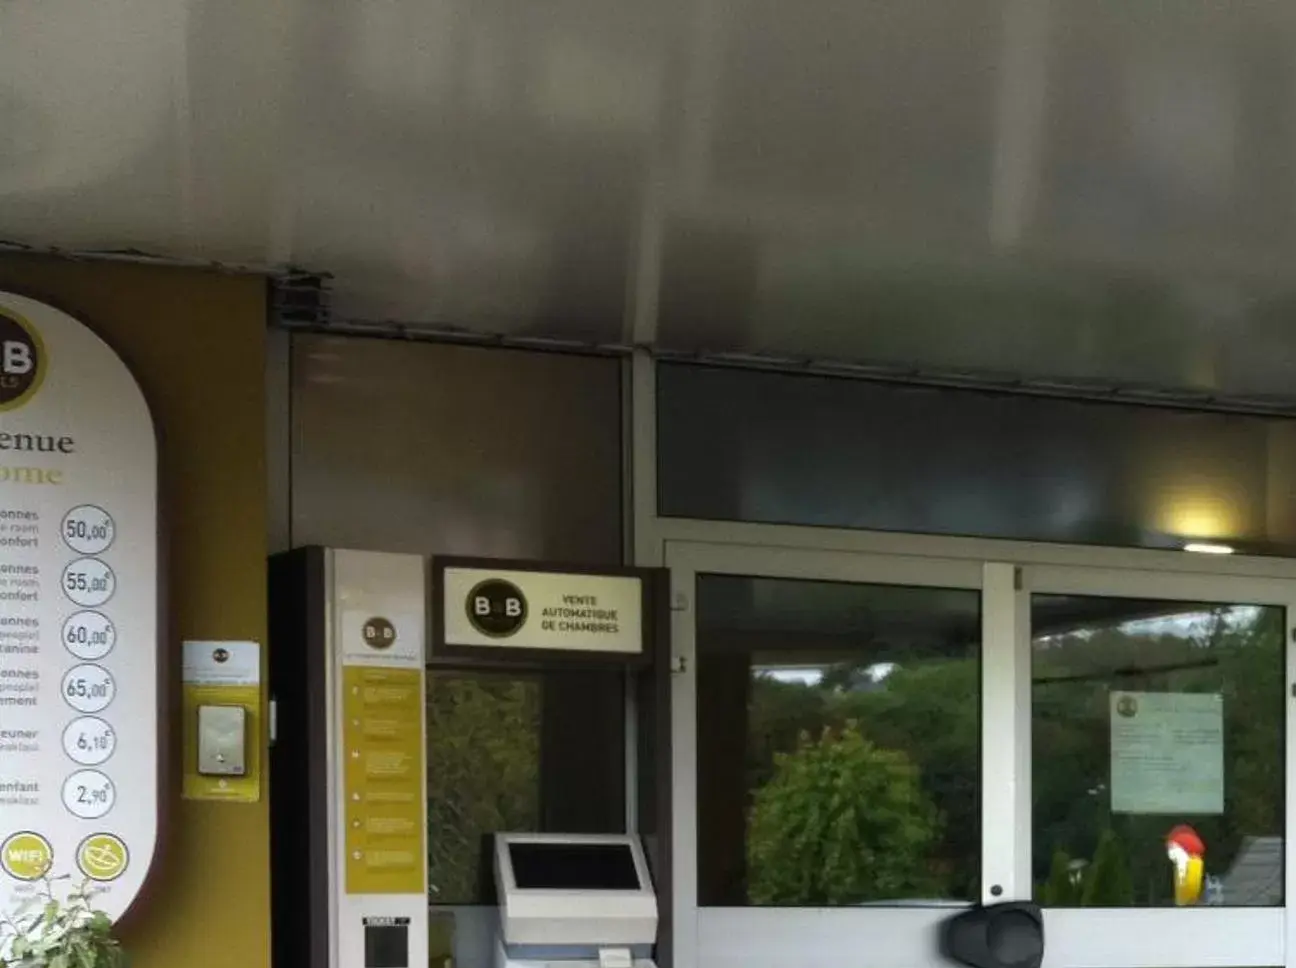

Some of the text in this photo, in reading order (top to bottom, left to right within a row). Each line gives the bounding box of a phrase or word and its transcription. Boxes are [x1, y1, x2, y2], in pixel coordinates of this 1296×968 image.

[562, 594, 597, 606] VENTE
[541, 607, 618, 621] AUTOMATIQUE
[541, 620, 619, 634] DE CHAMBRES
